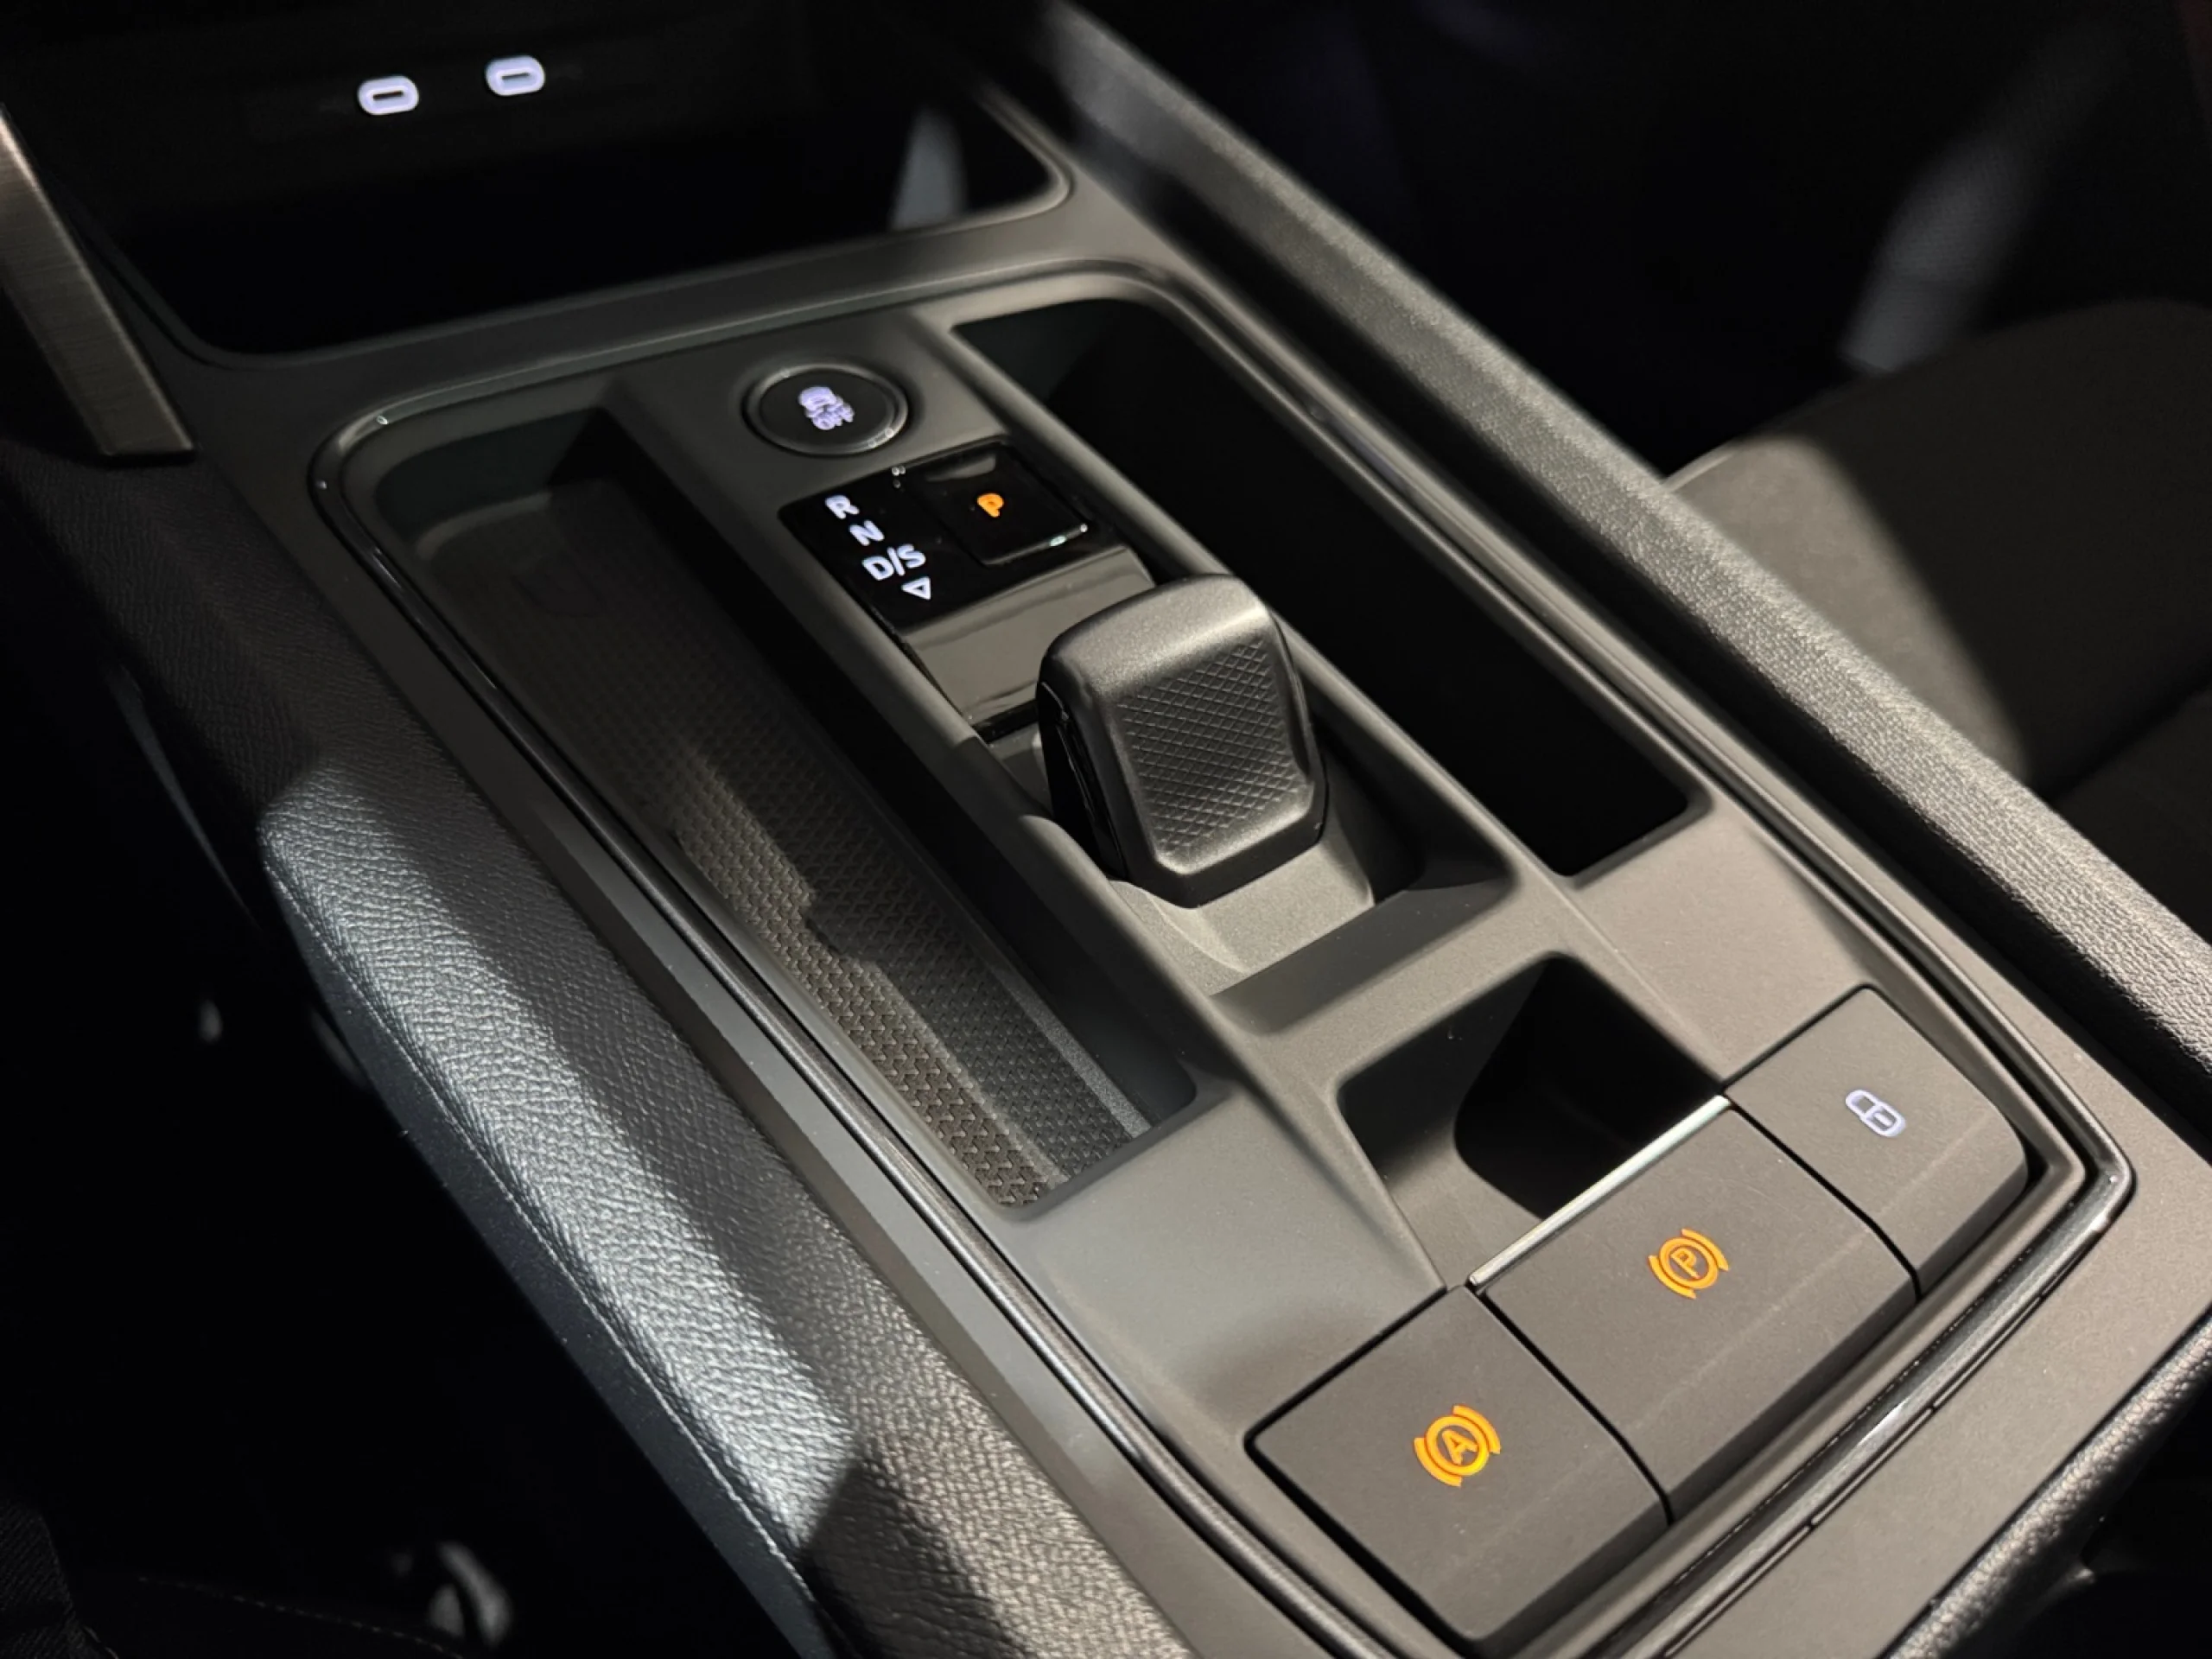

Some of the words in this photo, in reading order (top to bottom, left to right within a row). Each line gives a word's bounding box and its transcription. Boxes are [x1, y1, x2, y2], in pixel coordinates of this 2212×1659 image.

[825, 494, 860, 519] R
[976, 493, 1004, 518] P
[849, 519, 885, 546] N
[861, 543, 926, 581] D/S
[1669, 1247, 1700, 1280] P
[1441, 1428, 1478, 1465] A
